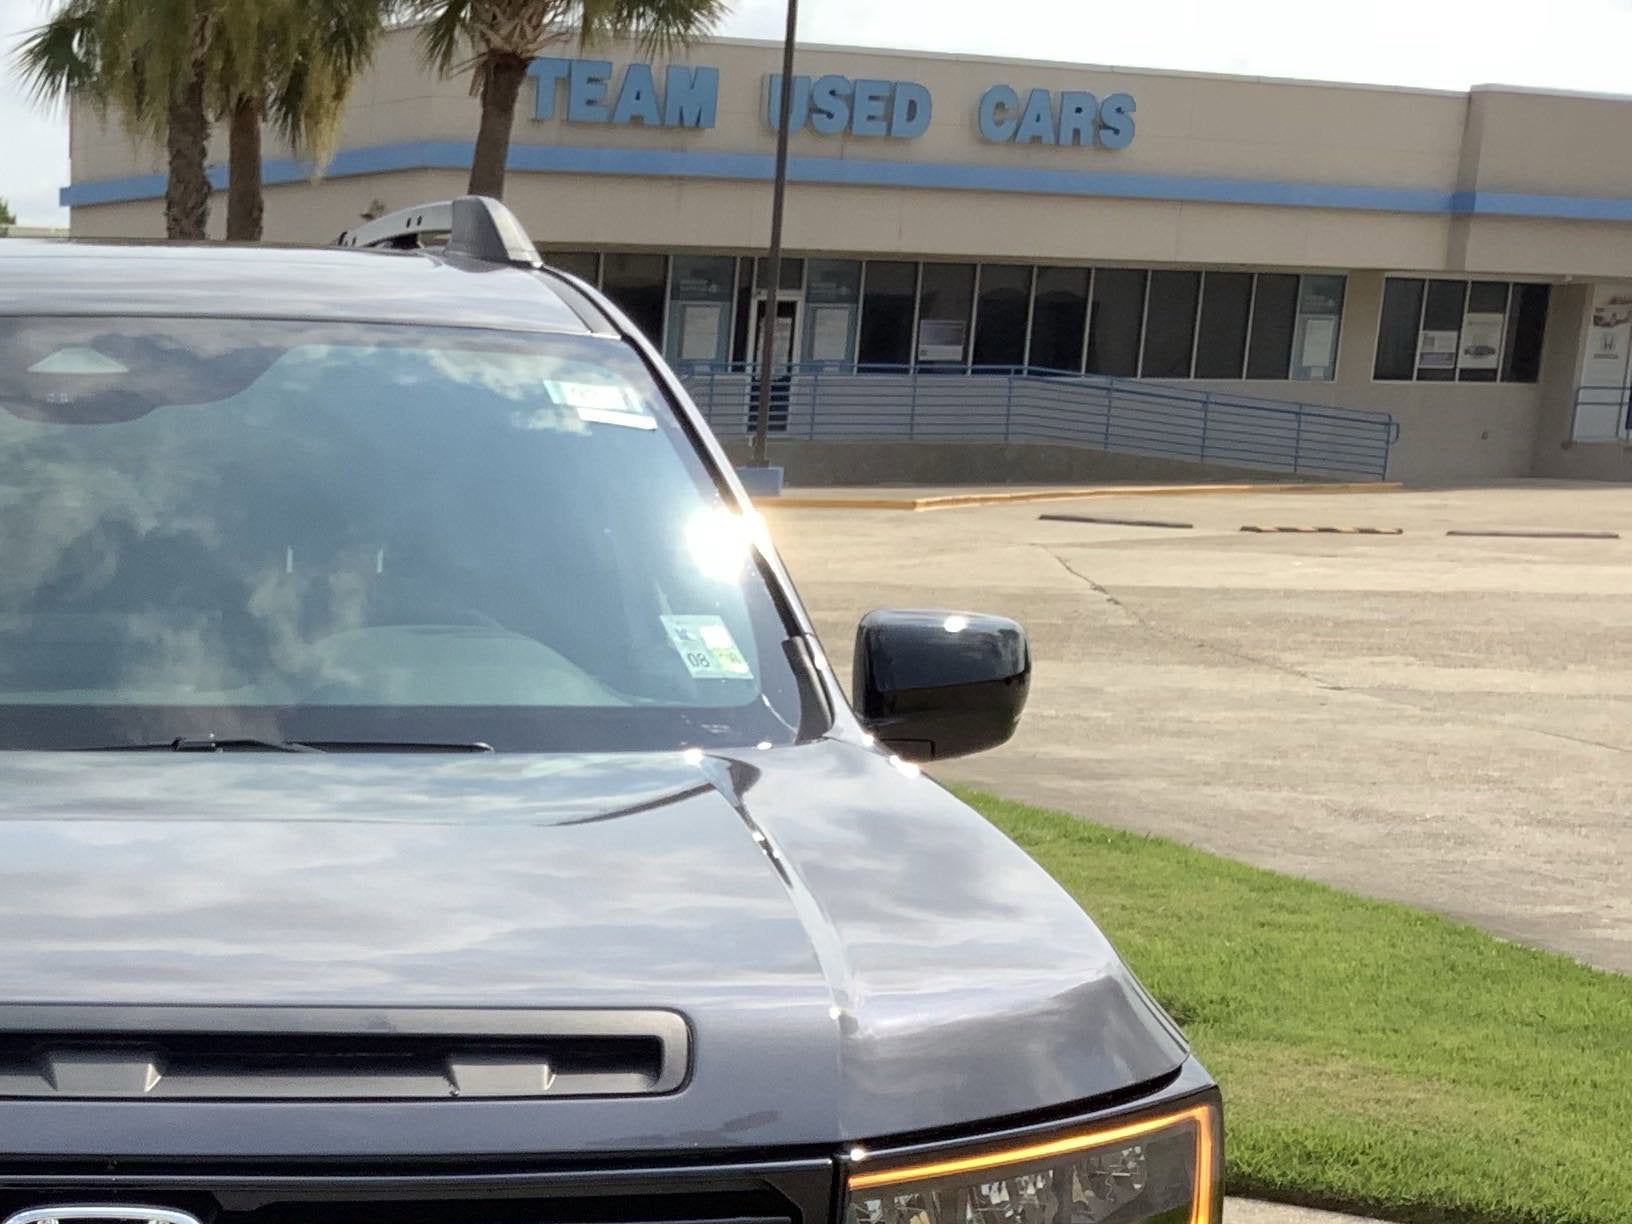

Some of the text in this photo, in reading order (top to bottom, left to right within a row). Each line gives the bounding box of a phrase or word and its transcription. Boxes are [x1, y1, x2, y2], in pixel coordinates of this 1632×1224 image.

[529, 56, 1137, 150] TEAM USED CARS
